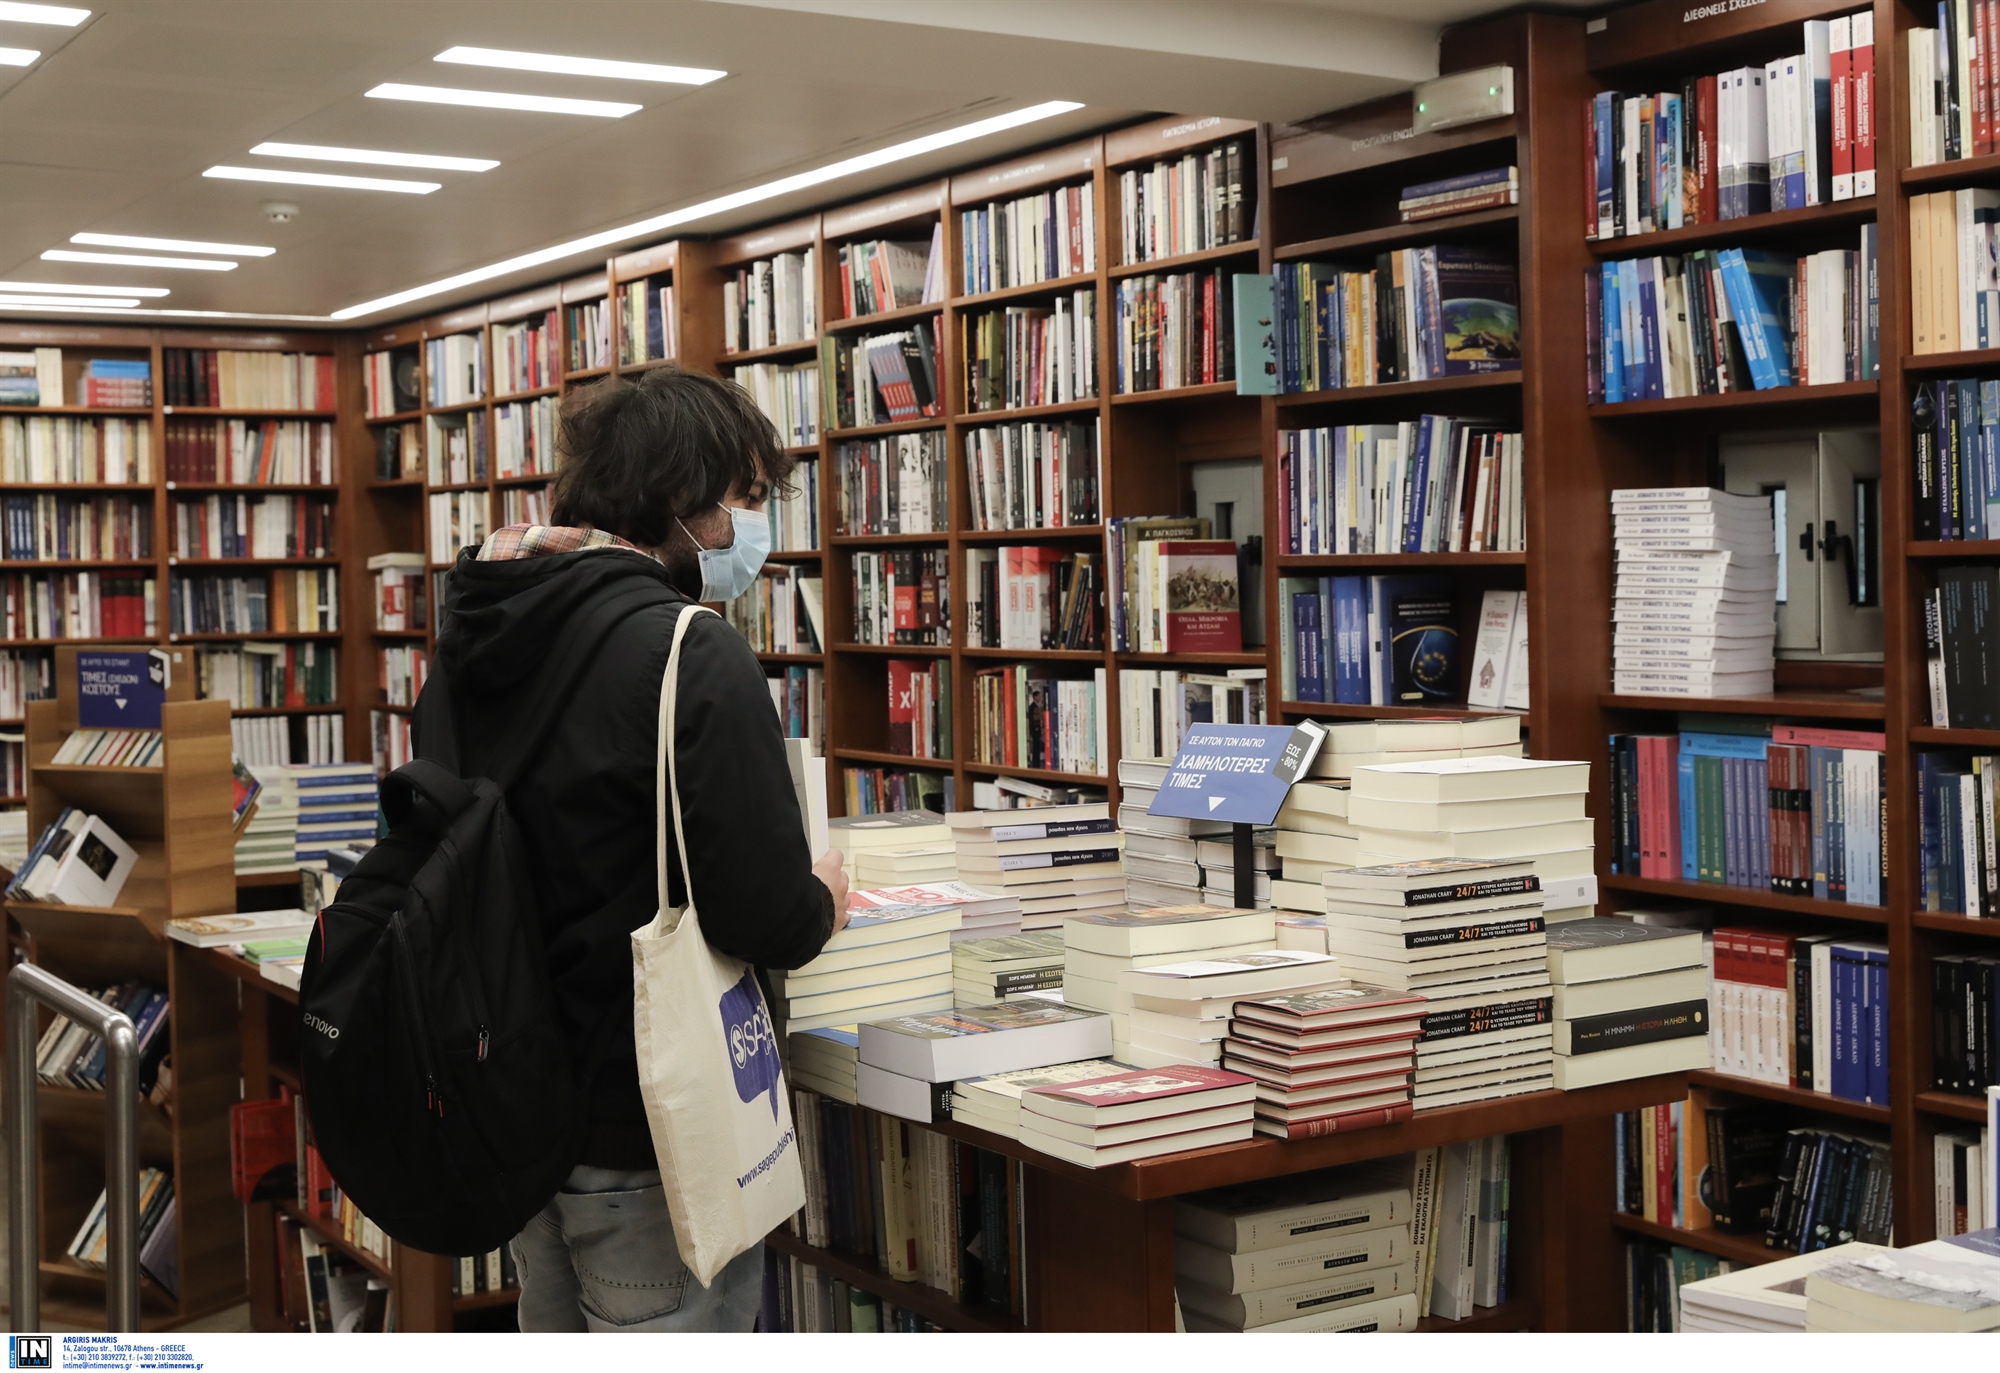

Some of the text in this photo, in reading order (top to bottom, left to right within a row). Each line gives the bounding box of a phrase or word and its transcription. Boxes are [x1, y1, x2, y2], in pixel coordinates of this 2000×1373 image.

[1683, 2, 1726, 22] ΔΙΕΘΝΕΙΣ
[1925, 598, 1933, 640] ΕΠΟΜΕΝΗ
[81, 672, 107, 682] ΤΙΜΕΣ
[82, 684, 120, 695] ΚΟΣΤΟΥΣ
[1189, 736, 1265, 748] ΣΕ ΑΥΤΟΝ ΤΟΝ ΠΑΓΚΟ
[1285, 743, 1302, 758] ΕΩΣ
[1176, 754, 1270, 774] ΧΑΜΗΛΟΤΕΡΕΣ
[1169, 773, 1207, 789] ΤΙΜΕΣ
[1456, 886, 1476, 897] 24/7
[1413, 935, 1438, 943] JONATHAN
[1459, 928, 1480, 939] 24/7
[1426, 1015, 1450, 1023] JONATHAN
[1470, 1007, 1490, 1019] 24/7
[1470, 1020, 1489, 1032] 24/7
[1611, 1025, 1635, 1034] ΜΝΗΜΗ
[1641, 1020, 1663, 1030] ΙΣΤΟΡΙΑ
[1669, 1016, 1687, 1025] ΛΗΘΗ
[1426, 1029, 1450, 1037] JONATHAN
[1424, 1155, 1433, 1195] ΣΥΣΤΗΜΑΤΑ
[1413, 1202, 1422, 1245] ΚΟΜΜΑΤΙΚΟ
[951, 1230, 956, 1239] ΜΕ
[1327, 1258, 1350, 1267] MEYNAUD
